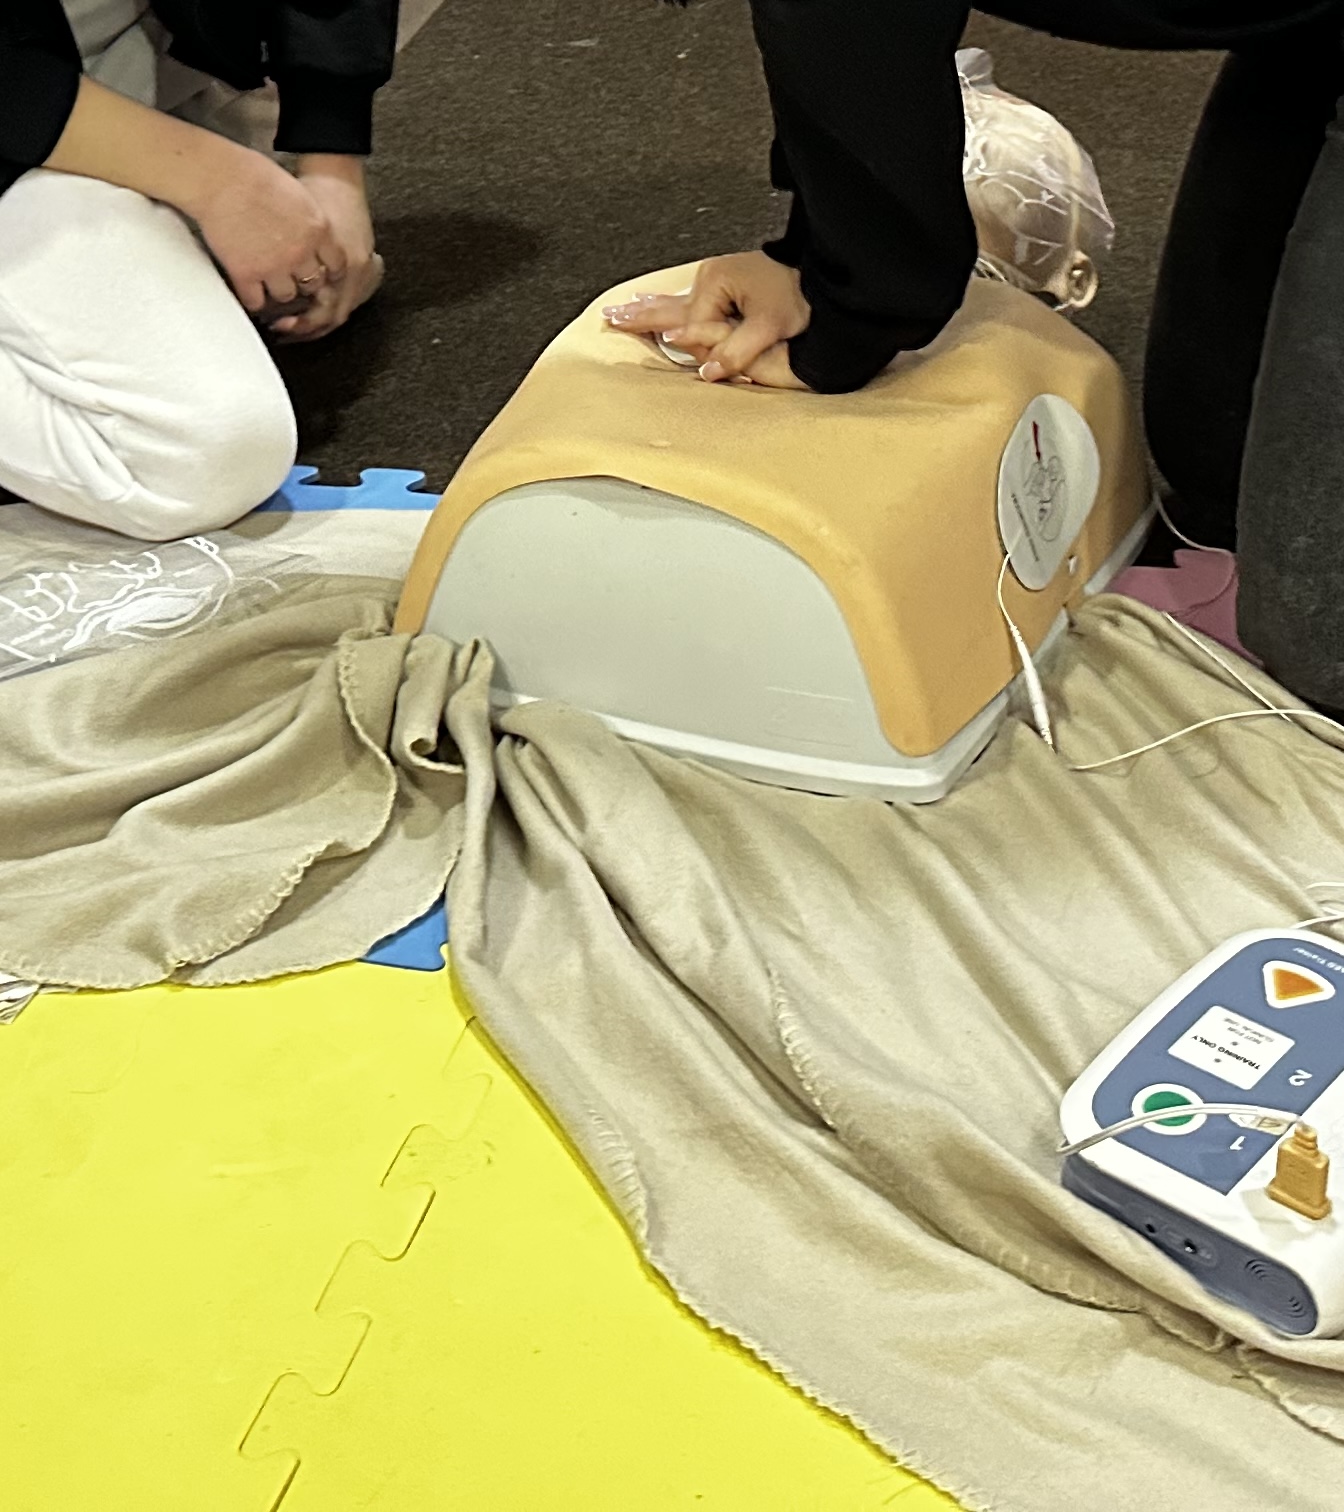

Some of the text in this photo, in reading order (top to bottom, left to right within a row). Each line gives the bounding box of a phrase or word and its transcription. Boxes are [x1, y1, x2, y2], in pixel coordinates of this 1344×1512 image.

[1191, 1035, 1261, 1070] TRAINING ONLY
[1288, 1069, 1313, 1086] 2
[1229, 1135, 1247, 1151] 1
